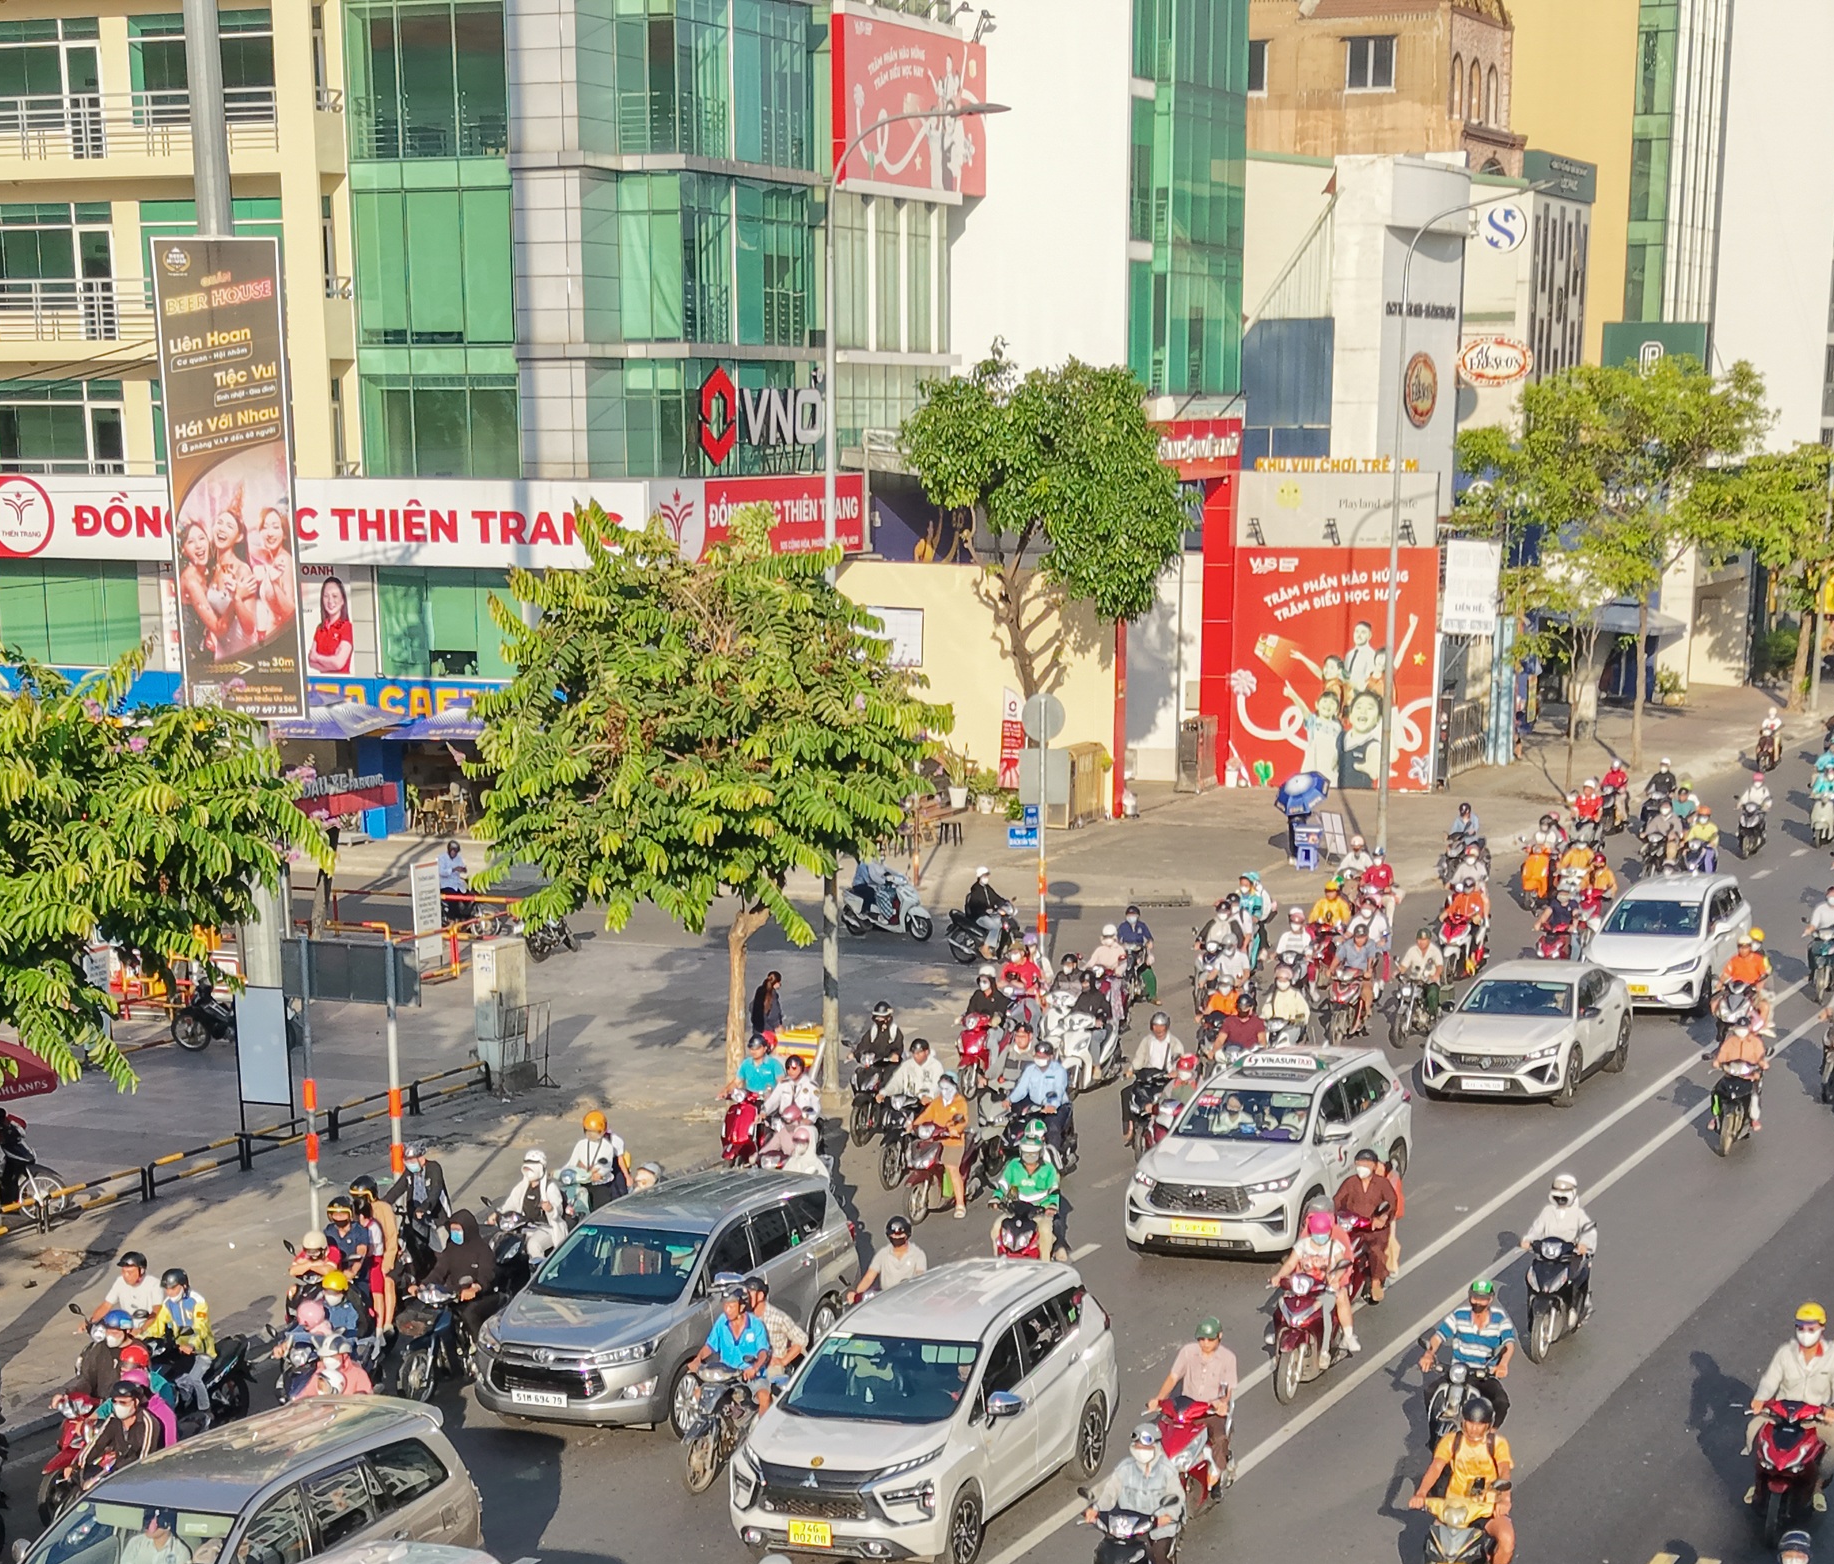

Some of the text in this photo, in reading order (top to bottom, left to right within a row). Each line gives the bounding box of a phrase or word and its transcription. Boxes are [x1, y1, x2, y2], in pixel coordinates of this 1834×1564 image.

[165, 279, 272, 316] BEER HOUSE
[169, 327, 251, 354] Liên Hoan
[189, 355, 208, 365] quan
[214, 361, 277, 389] Tiệc Vui
[175, 405, 279, 440] Hát Với Nhau
[181, 442, 188, 453] 8
[189, 439, 213, 452] phòng
[1255, 458, 1284, 473] KHU
[1289, 458, 1316, 473] VUI
[1319, 456, 1357, 473] CHƠI
[783, 492, 818, 524] THIÊN
[819, 495, 859, 524] TANG
[1339, 499, 1380, 511] Playland
[71, 491, 172, 539] ĐỒN
[331, 498, 460, 543] THIÊN
[302, 565, 334, 576] OANH
[1249, 557, 1277, 573] VUS
[1263, 585, 1300, 607] TRĂM
[1341, 570, 1368, 587] HÀO
[1274, 597, 1311, 622] TRĂM
[272, 657, 295, 667] 30m
[235, 685, 283, 695] ooking Online
[246, 706, 259, 714] 097
[262, 706, 276, 714] 697
[349, 773, 384, 791] PARKING
[1261, 1056, 1313, 1066] VINASUN TAXI
